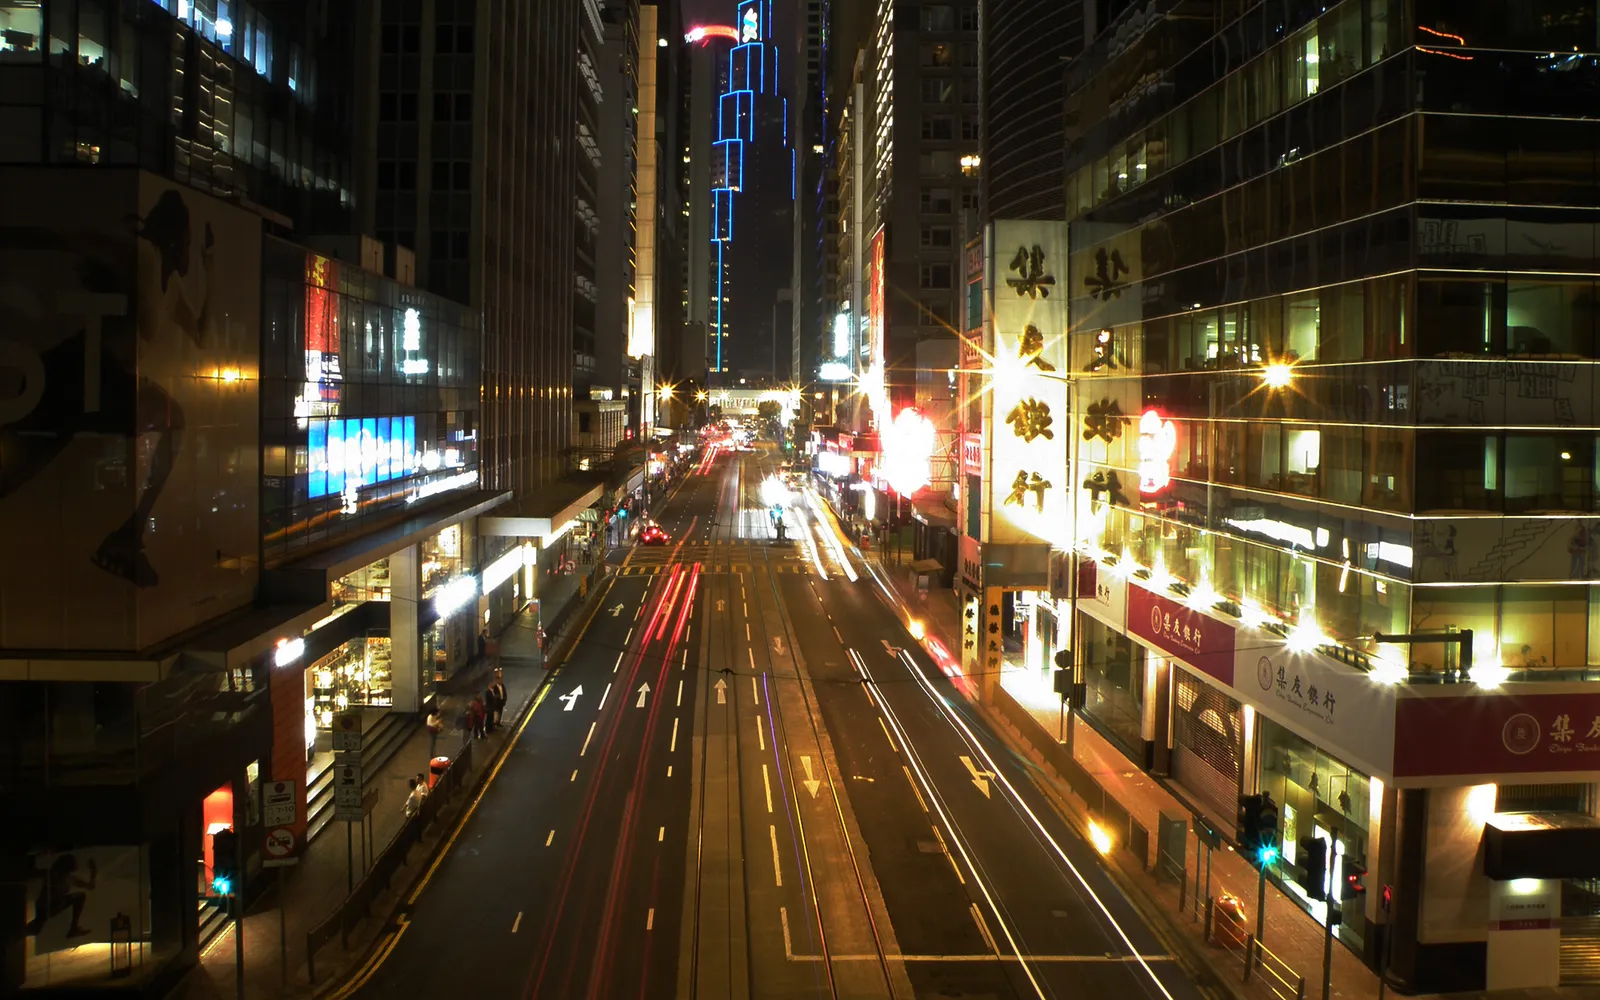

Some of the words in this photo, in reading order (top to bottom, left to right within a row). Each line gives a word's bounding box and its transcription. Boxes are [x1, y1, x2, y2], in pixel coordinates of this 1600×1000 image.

[1163, 612, 1202, 648] 集友銀行
[1276, 665, 1336, 715] 集友銀行
